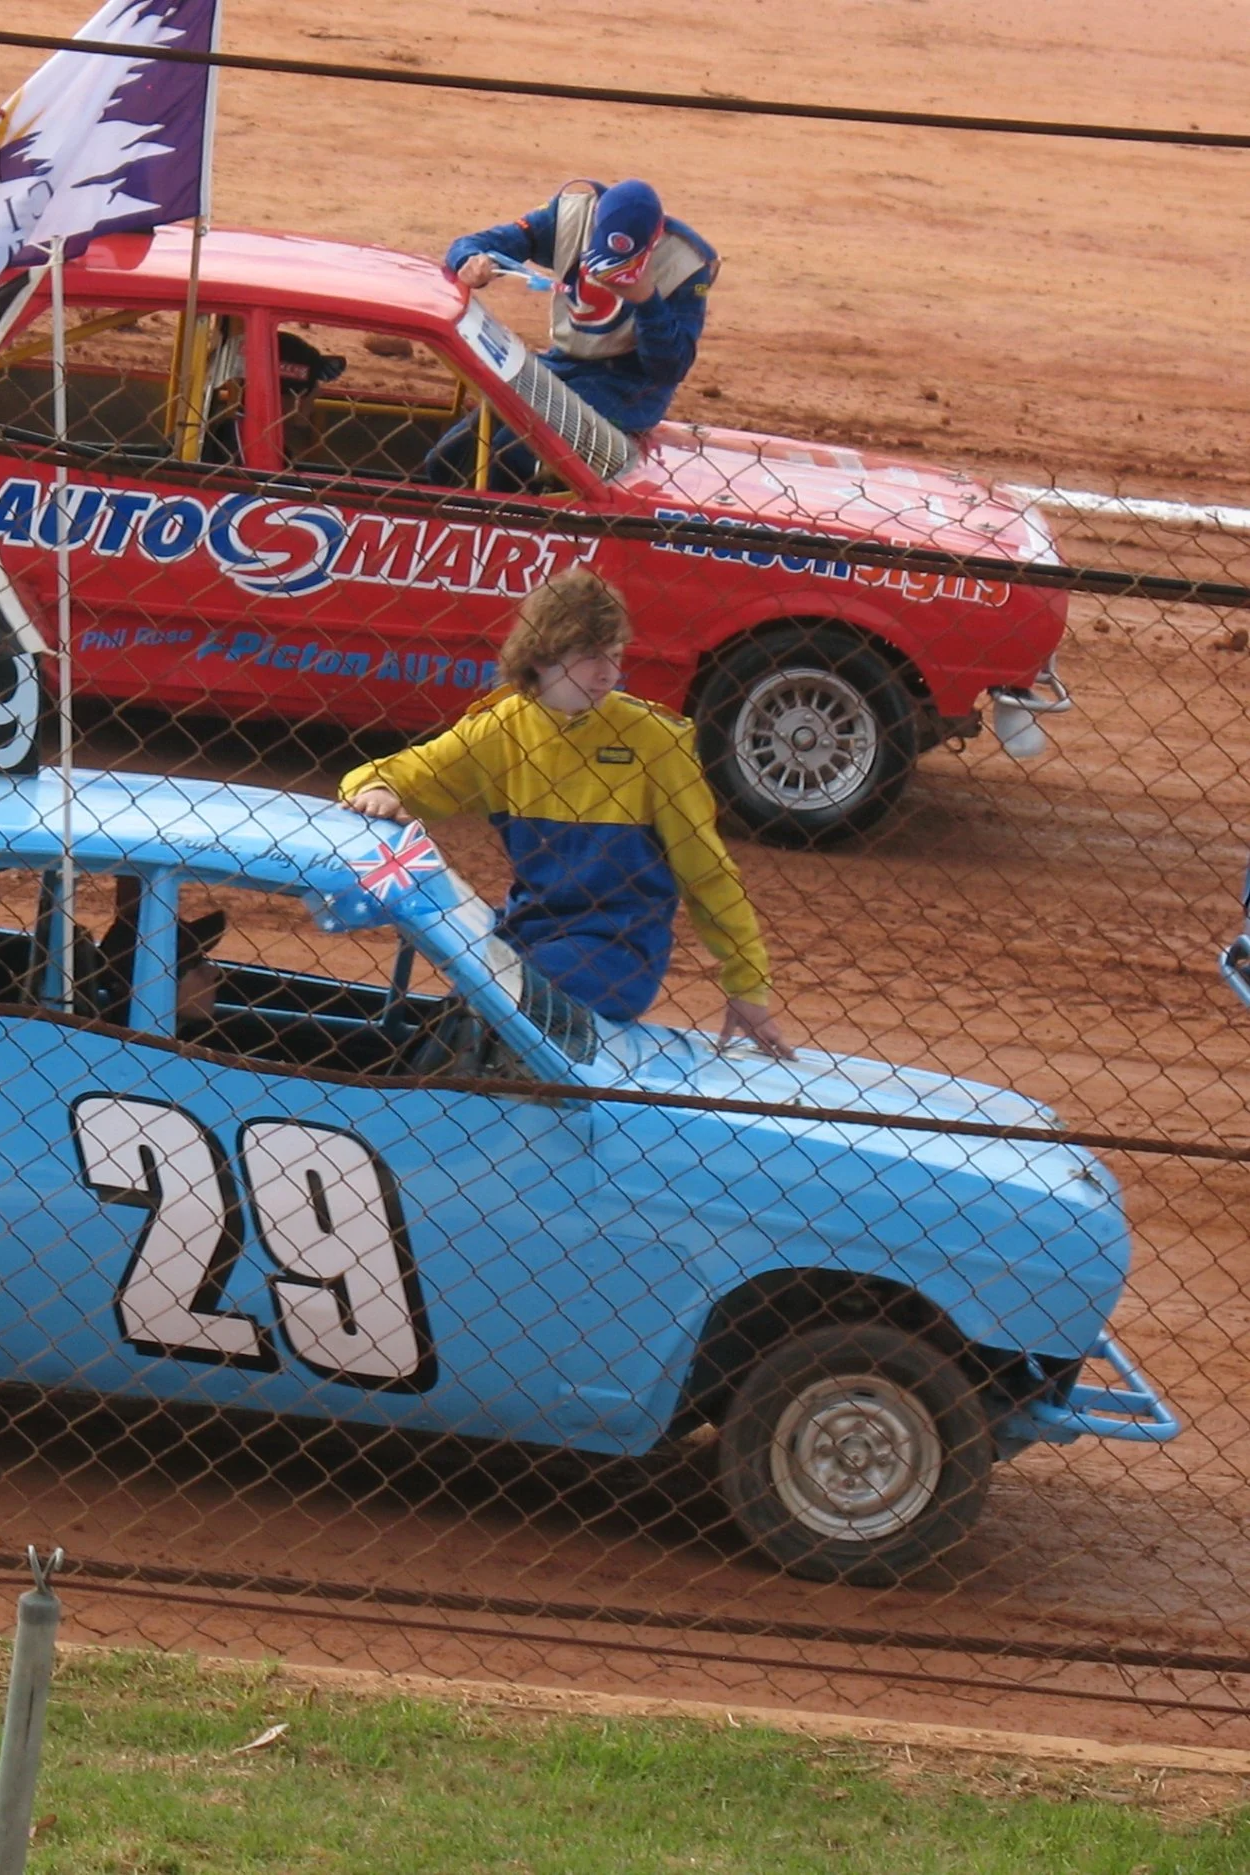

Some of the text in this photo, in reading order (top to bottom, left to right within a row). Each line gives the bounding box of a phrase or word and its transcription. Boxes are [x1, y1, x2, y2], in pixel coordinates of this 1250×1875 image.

[81, 628, 128, 651] Phil
[224, 632, 371, 678] Picton
[69, 1092, 438, 1394] 29
